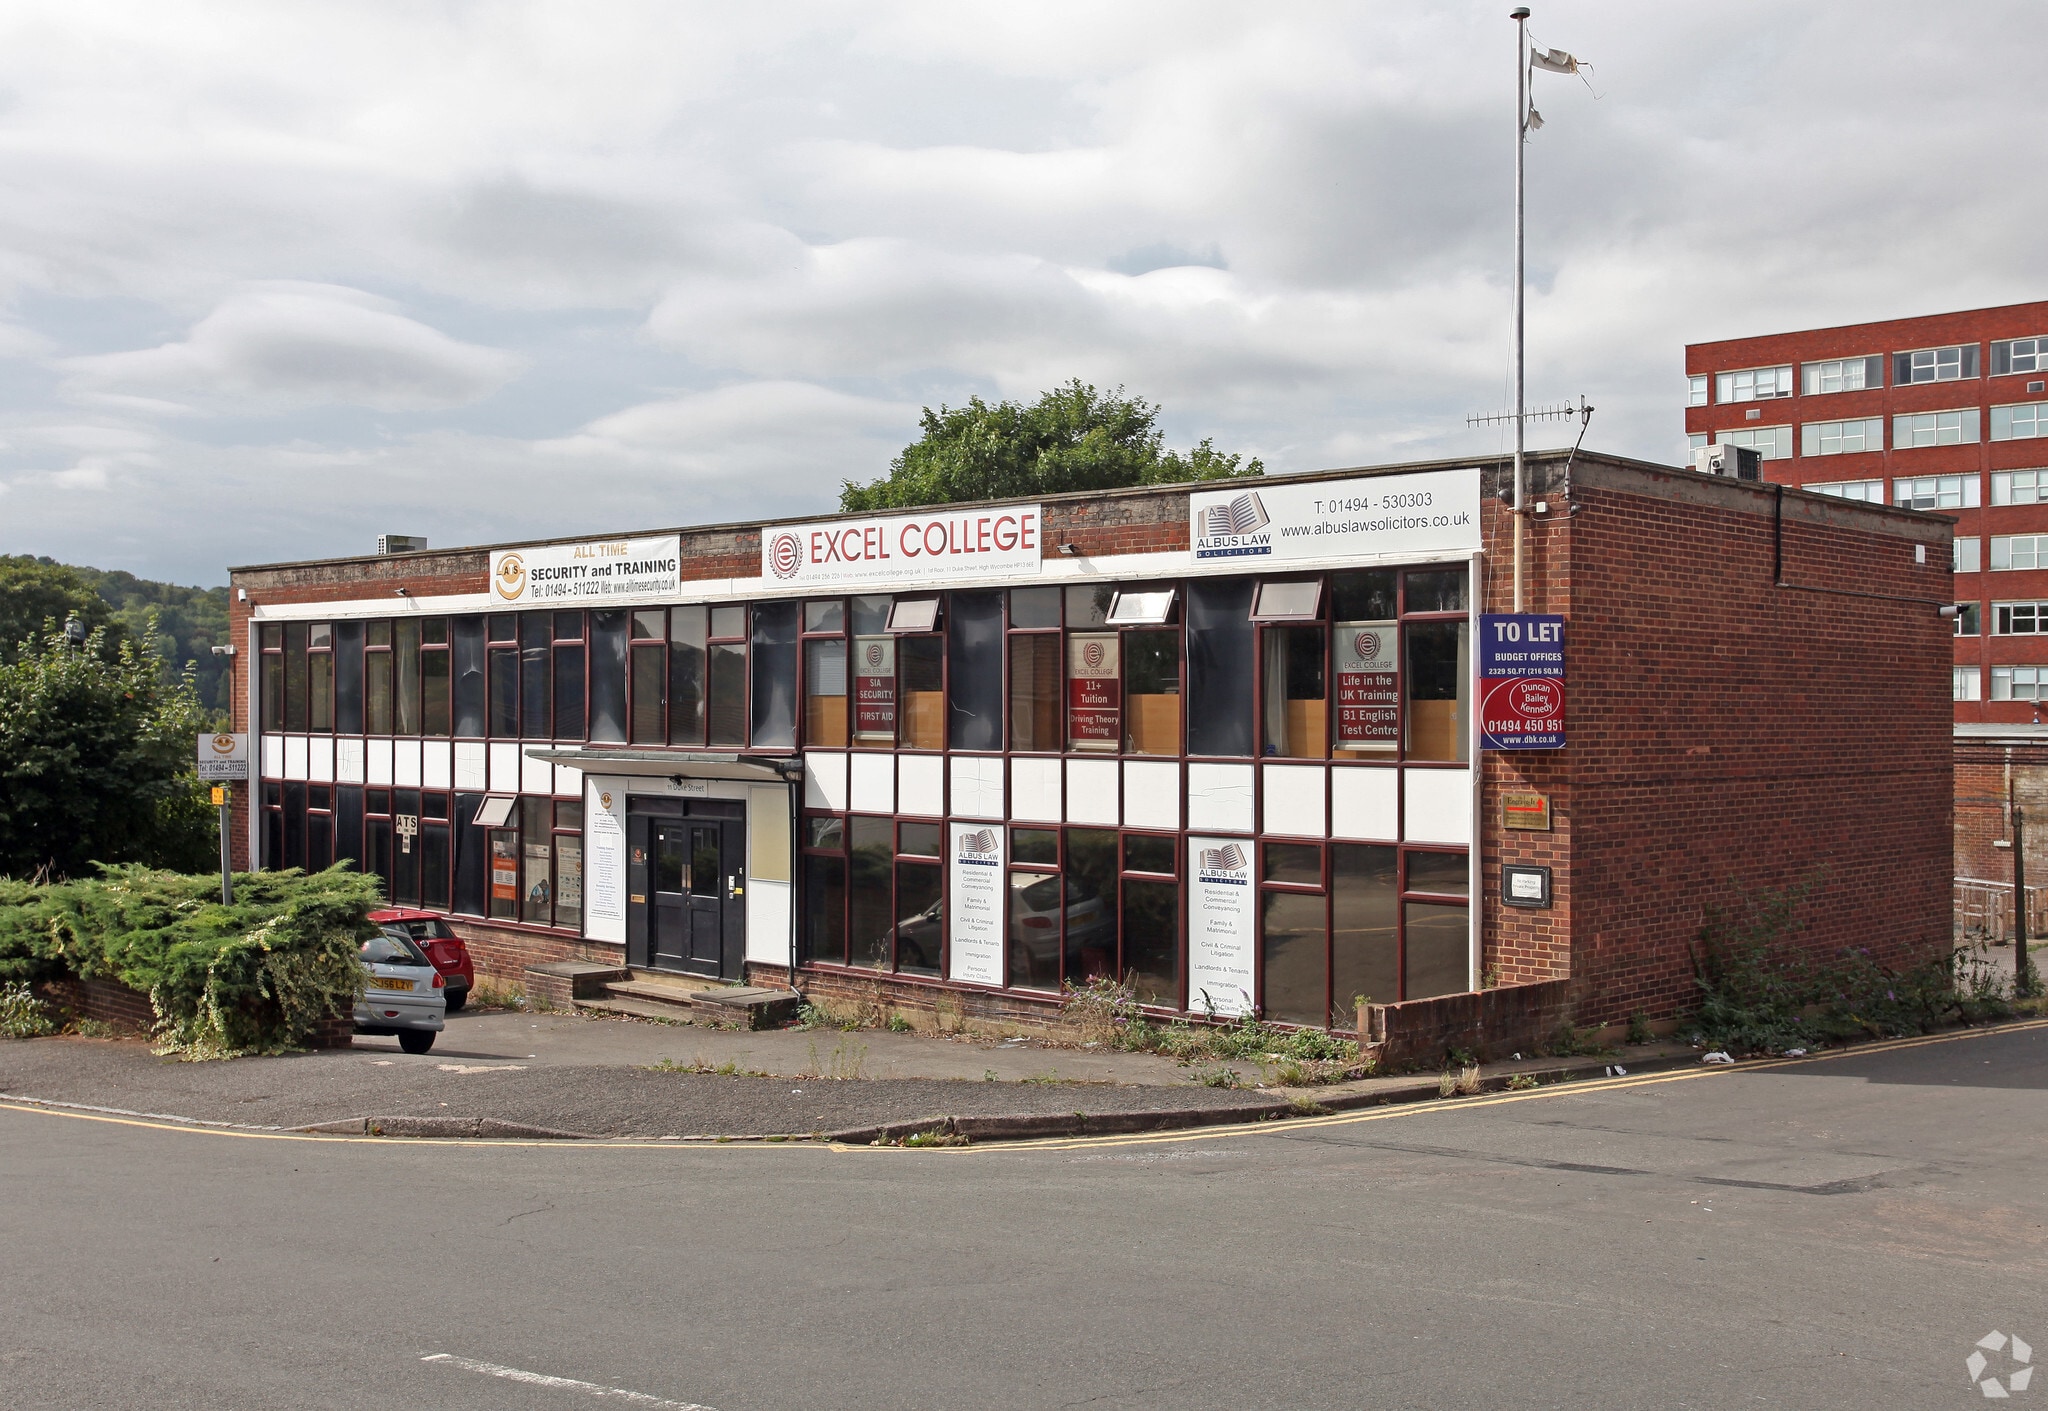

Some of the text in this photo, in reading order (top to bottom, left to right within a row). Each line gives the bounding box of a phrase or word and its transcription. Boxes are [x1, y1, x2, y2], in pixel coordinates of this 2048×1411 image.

[1314, 501, 1325, 515] T:
[1329, 497, 1369, 514] 01494
[1382, 492, 1433, 509] 530303
[1281, 511, 1470, 538] www.albuslawsolicitors.co.uk
[811, 514, 1035, 564] EXCEL COLLEGE
[1197, 533, 1271, 548] ALBUS LAW
[574, 542, 628, 559] ALL TIME
[1197, 547, 1271, 558] SOLICITORS
[531, 558, 676, 581] SECURITY and TRAINING
[806, 573, 820, 581] 01494
[990, 562, 1013, 571] Wycombe
[531, 584, 544, 598] Tel:
[600, 580, 612, 594] Web:
[1493, 622, 1562, 643] TO LET
[1495, 652, 1562, 662] BUDGET OFFICES
[1527, 668, 1542, 676] (216
[869, 678, 881, 687] SIA
[1086, 681, 1102, 690] 11+
[1342, 674, 1392, 686] Life in the
[1520, 683, 1551, 694] Duncan
[860, 690, 893, 699] SECURITY
[1080, 694, 1108, 704] Tuition
[1340, 690, 1398, 702] UK Training
[1525, 694, 1549, 704] Bailey
[1520, 702, 1553, 714] Kennedy
[860, 712, 894, 720] FIRST AID
[1070, 714, 1118, 726] Driving Theory
[1343, 710, 1396, 722] B1 English
[1081, 726, 1109, 736] Training
[1342, 724, 1398, 736] Test Centre
[1488, 719, 1563, 733] 01494 450 951
[1502, 735, 1557, 744] www.dbk.co.uk
[688, 784, 704, 792] Street
[1199, 869, 1228, 877] ALBUS
[961, 883, 994, 892] Conveyancing
[1203, 904, 1240, 913] Conveyancing
[1206, 927, 1237, 935] Matrimonial
[1194, 964, 1222, 972] Landlords
[1228, 967, 1249, 975] Tenants
[1206, 980, 1238, 988] Immigration
[1210, 995, 1234, 1003] Personal
[1220, 1004, 1239, 1012] Claims
